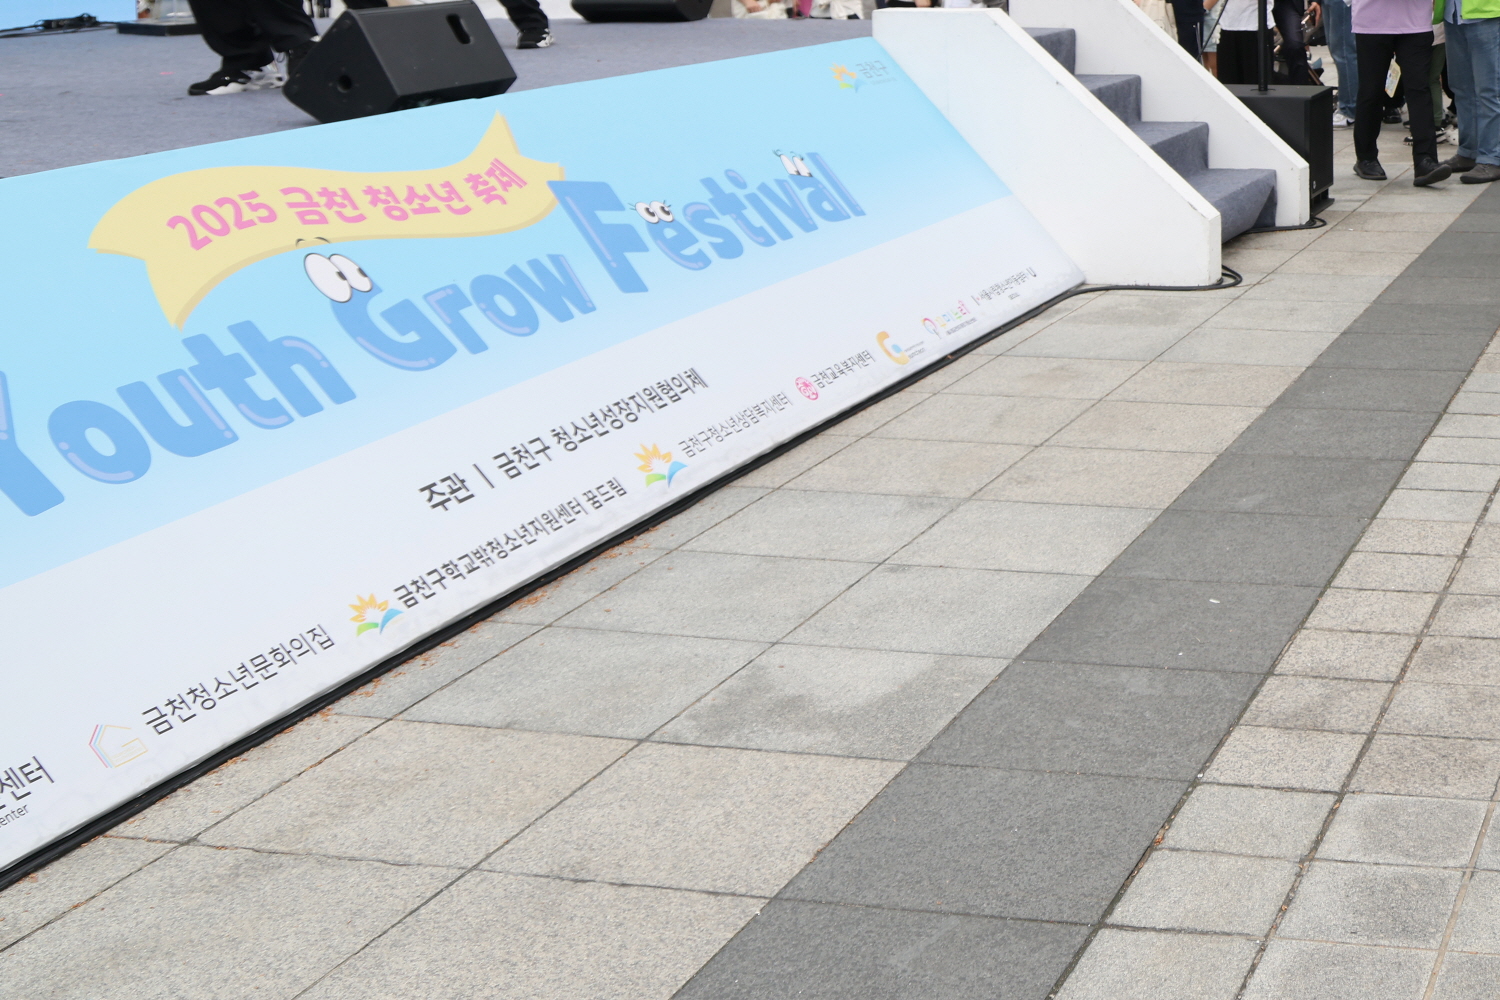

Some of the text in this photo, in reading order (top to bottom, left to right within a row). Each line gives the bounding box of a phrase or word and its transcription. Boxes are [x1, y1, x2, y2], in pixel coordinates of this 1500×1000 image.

[166, 157, 528, 251] 2025 금천 청소년 축제
[331, 253, 597, 373] Grow
[546, 151, 867, 324] Festival
[677, 391, 794, 458] 금천구청소년상담복지센터
[810, 350, 877, 389] 금천교육복지센터
[418, 366, 709, 512] 주관 금천구 청소년성장지원협의체
[392, 476, 628, 610] 금천구학교밖청소년지원센터 꿈드림
[141, 624, 337, 736] 금천청소년문화의집
